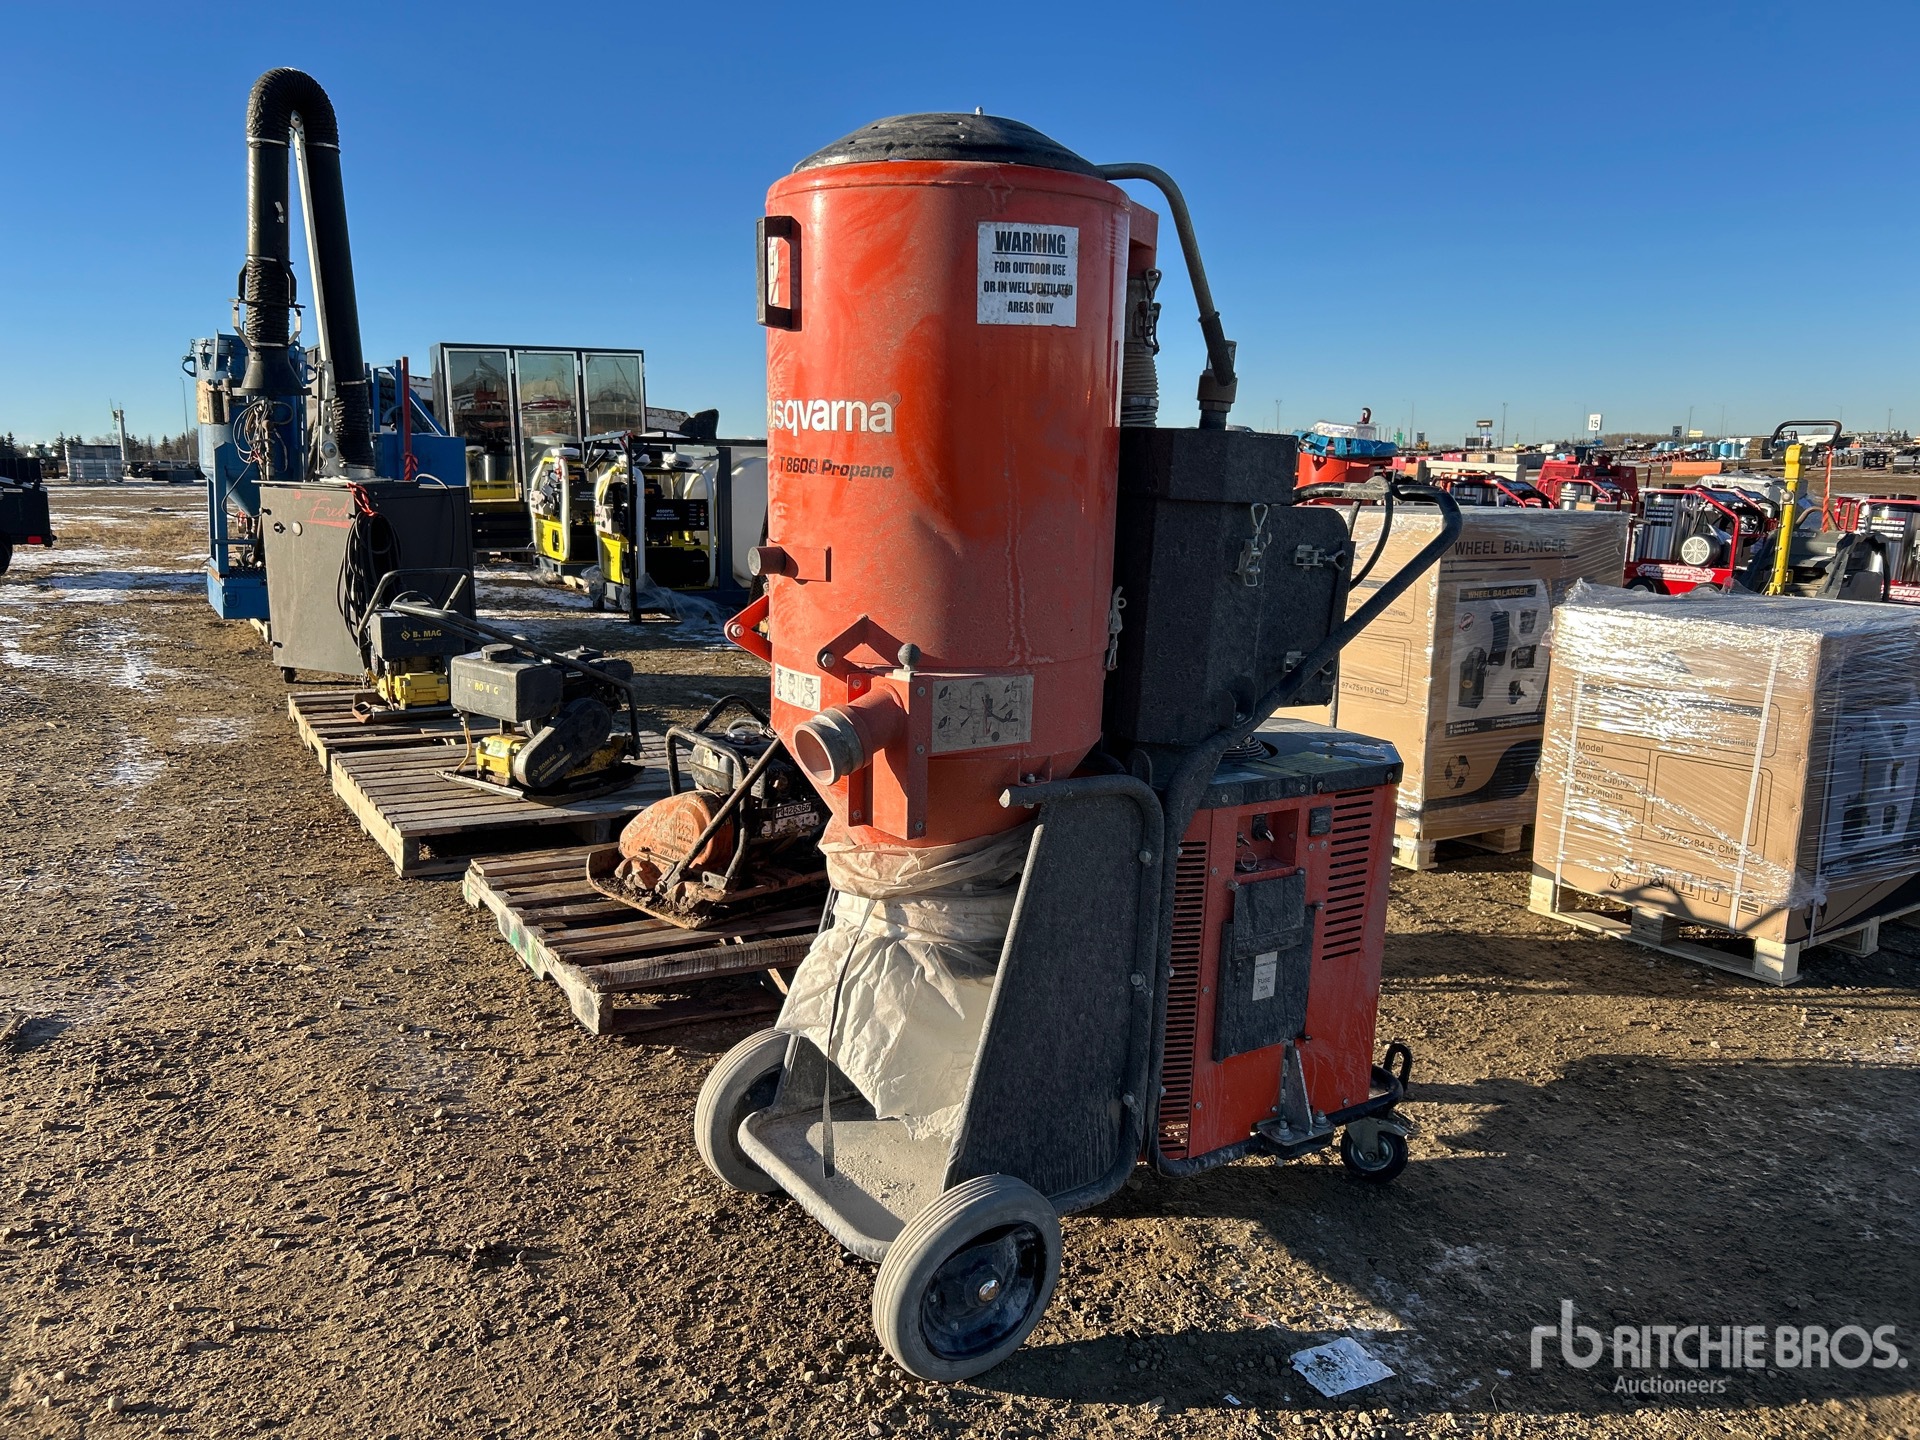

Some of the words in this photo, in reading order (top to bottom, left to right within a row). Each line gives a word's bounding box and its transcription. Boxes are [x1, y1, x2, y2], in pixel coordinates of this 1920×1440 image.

[995, 230, 1066, 255] WARNING
[994, 261, 1011, 273] FOR
[1012, 261, 1051, 275] OUTDOOR
[1052, 264, 1066, 276] USE
[983, 280, 996, 293] OR
[998, 281, 1007, 293] IN
[1008, 281, 1030, 294] WELL
[1031, 282, 1073, 296] VENTILATED
[1007, 300, 1034, 313] AREAS
[1035, 302, 1054, 314] ONLY
[1590, 419, 1599, 429] 15
[1674, 429, 1680, 437] 2
[786, 457, 818, 474] 8600
[821, 458, 895, 481] Propane
[1455, 541, 1498, 555] WHEEL
[1503, 539, 1567, 554] BALANCER
[1468, 591, 1491, 599] WHEEL
[1492, 587, 1529, 597] BALANCER
[1577, 741, 1604, 753] Model
[1576, 756, 1599, 767] Color
[1575, 769, 1601, 781] Power
[1602, 775, 1630, 789] supply
[1574, 784, 1589, 795] Net
[1718, 844, 1741, 856] CMS
